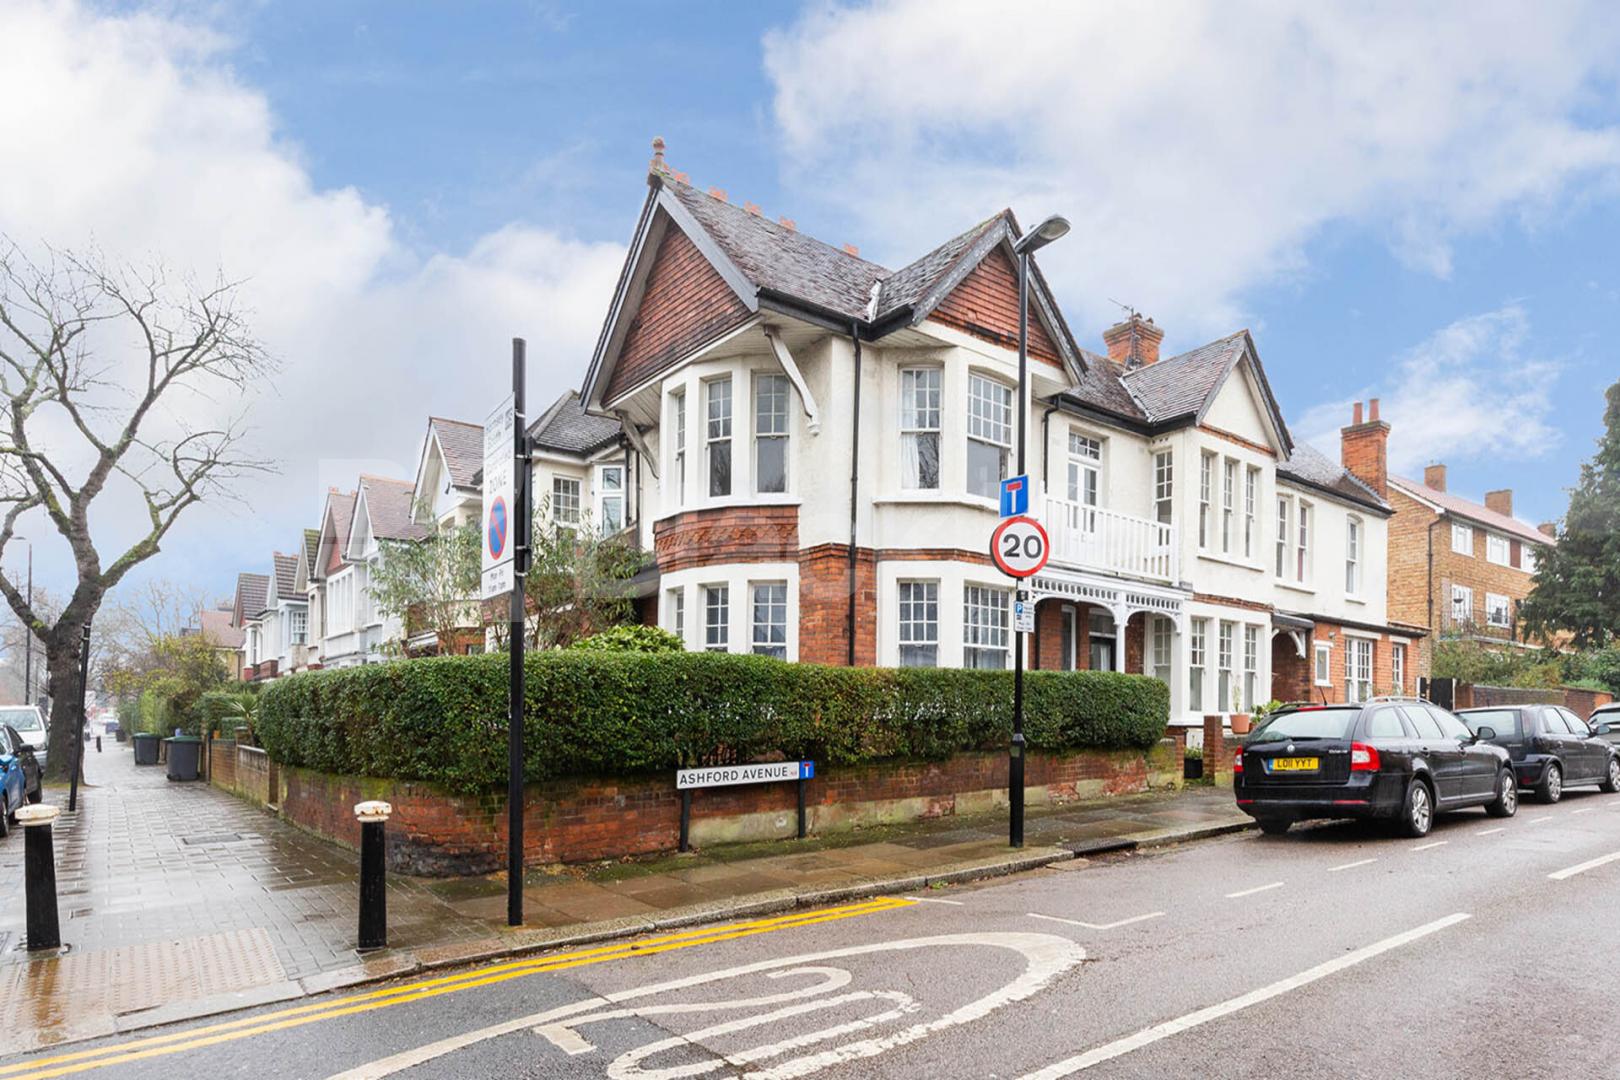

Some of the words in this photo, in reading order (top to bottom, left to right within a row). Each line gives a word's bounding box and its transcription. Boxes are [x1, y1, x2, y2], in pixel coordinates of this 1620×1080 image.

[1003, 533, 1043, 559] 20
[1295, 759, 1312, 768] YYT
[680, 771, 738, 785] ASHFORD
[742, 767, 788, 779] AVENUE
